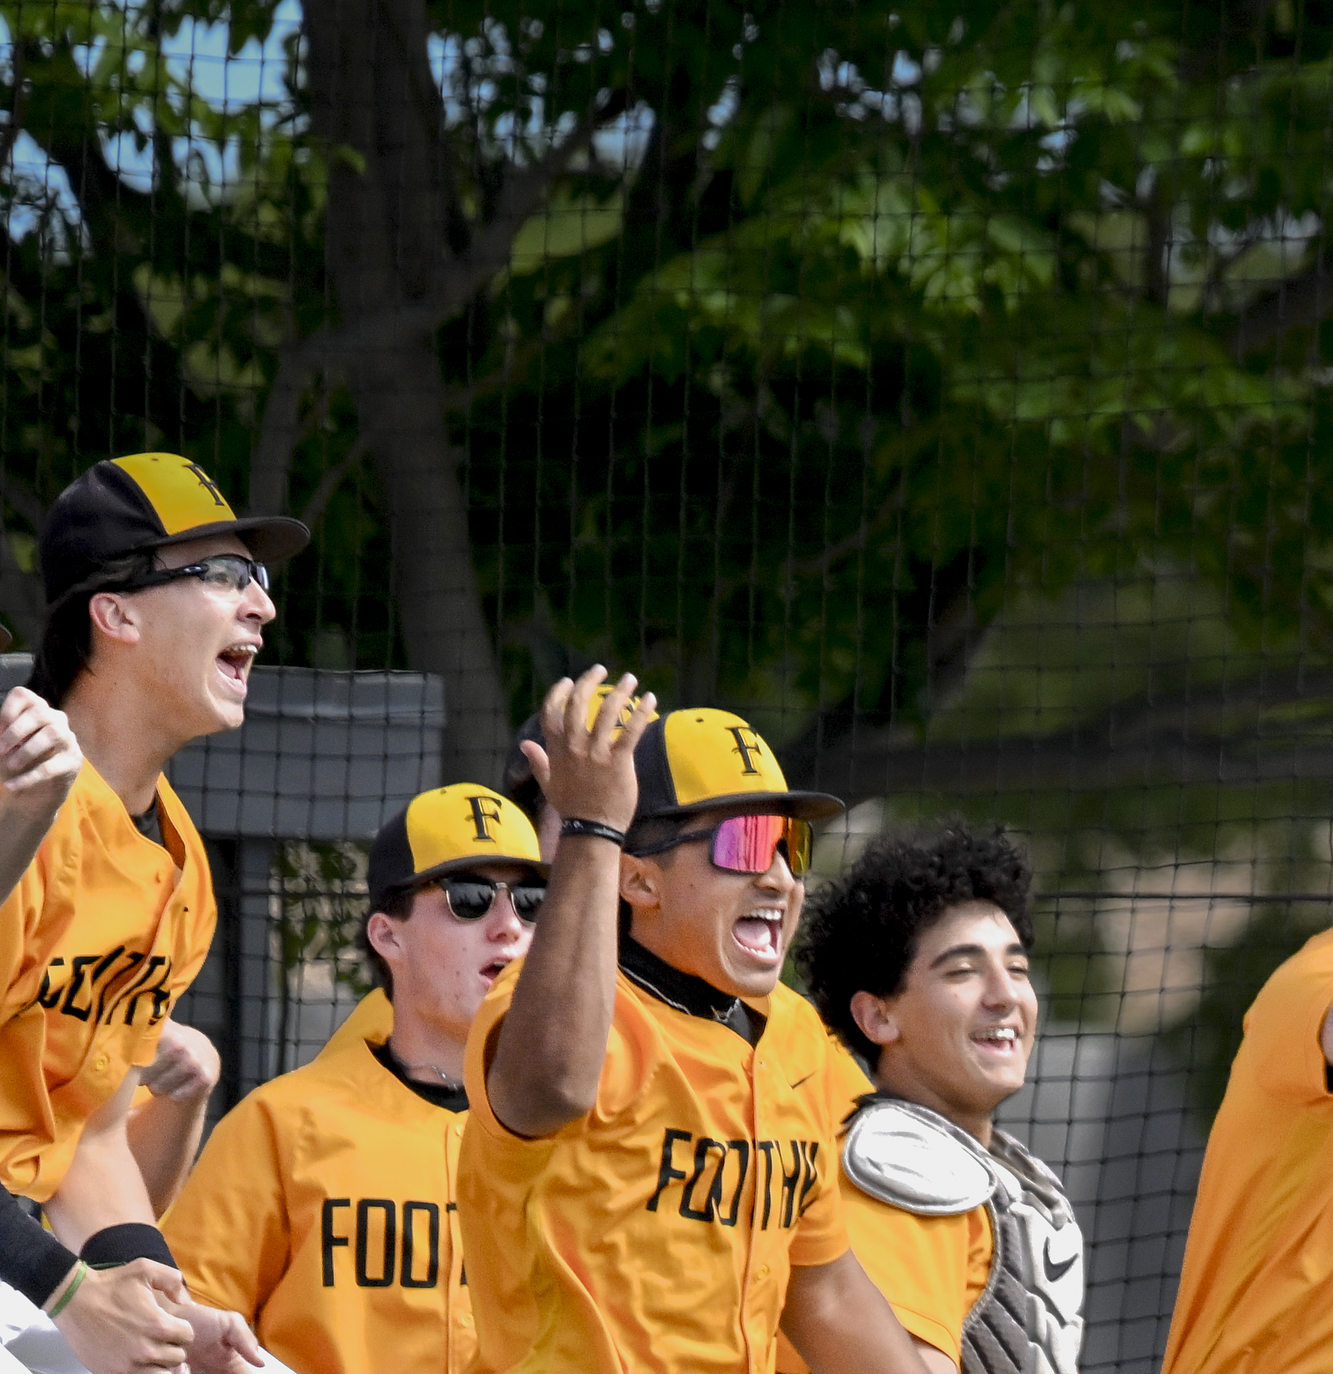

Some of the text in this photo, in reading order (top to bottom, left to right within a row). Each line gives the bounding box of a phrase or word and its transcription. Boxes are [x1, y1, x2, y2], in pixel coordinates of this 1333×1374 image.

[182, 463, 225, 506] F
[724, 726, 762, 776] F
[464, 795, 502, 843] F
